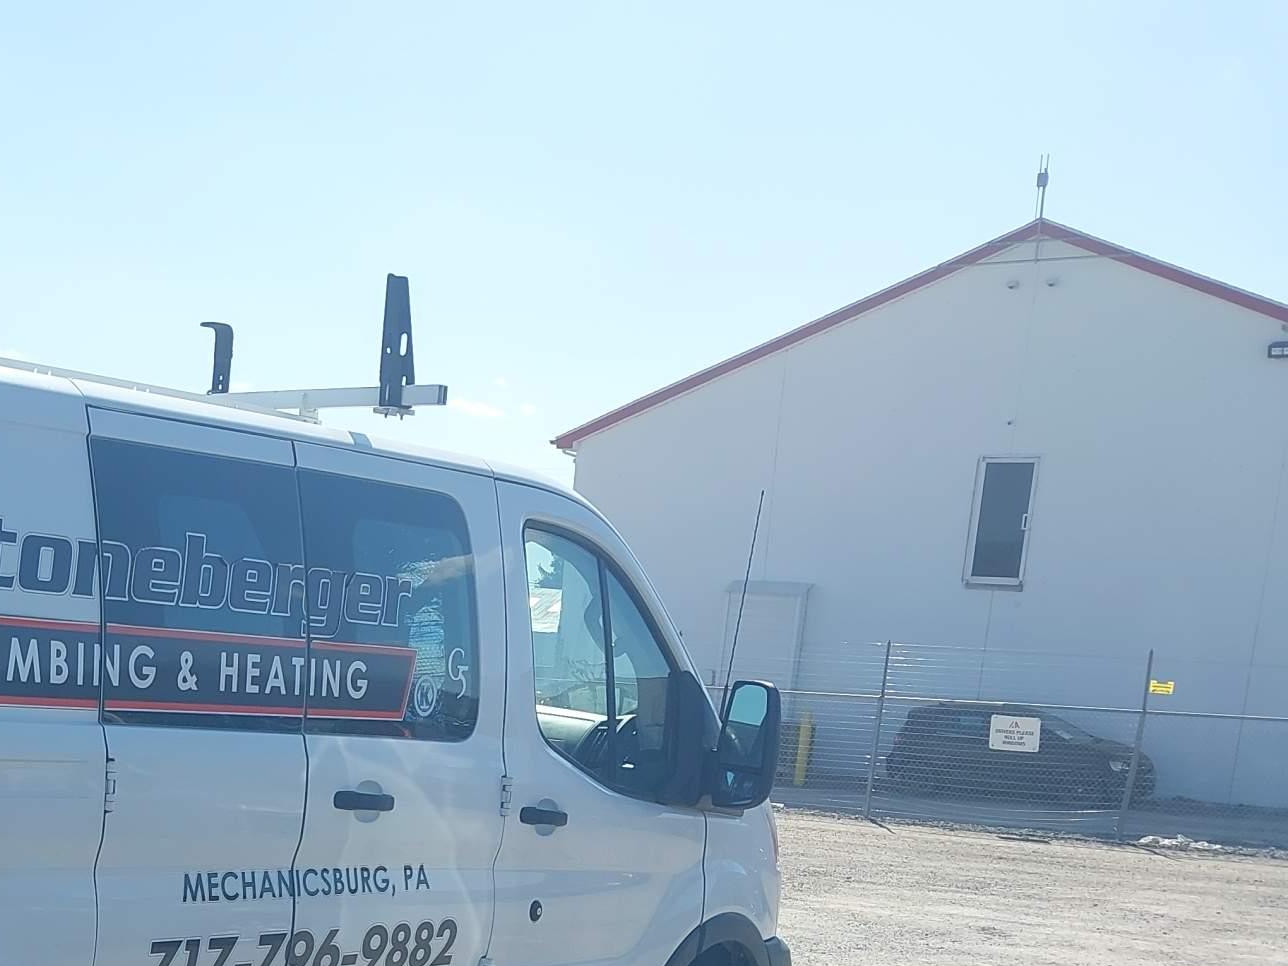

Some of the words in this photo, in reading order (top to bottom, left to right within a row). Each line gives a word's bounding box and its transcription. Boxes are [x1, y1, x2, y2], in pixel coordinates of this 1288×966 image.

[176, 650, 199, 692] &
[219, 652, 369, 699] HEATING
[182, 864, 396, 903] MECHANICSBURG,
[403, 863, 431, 891] PA
